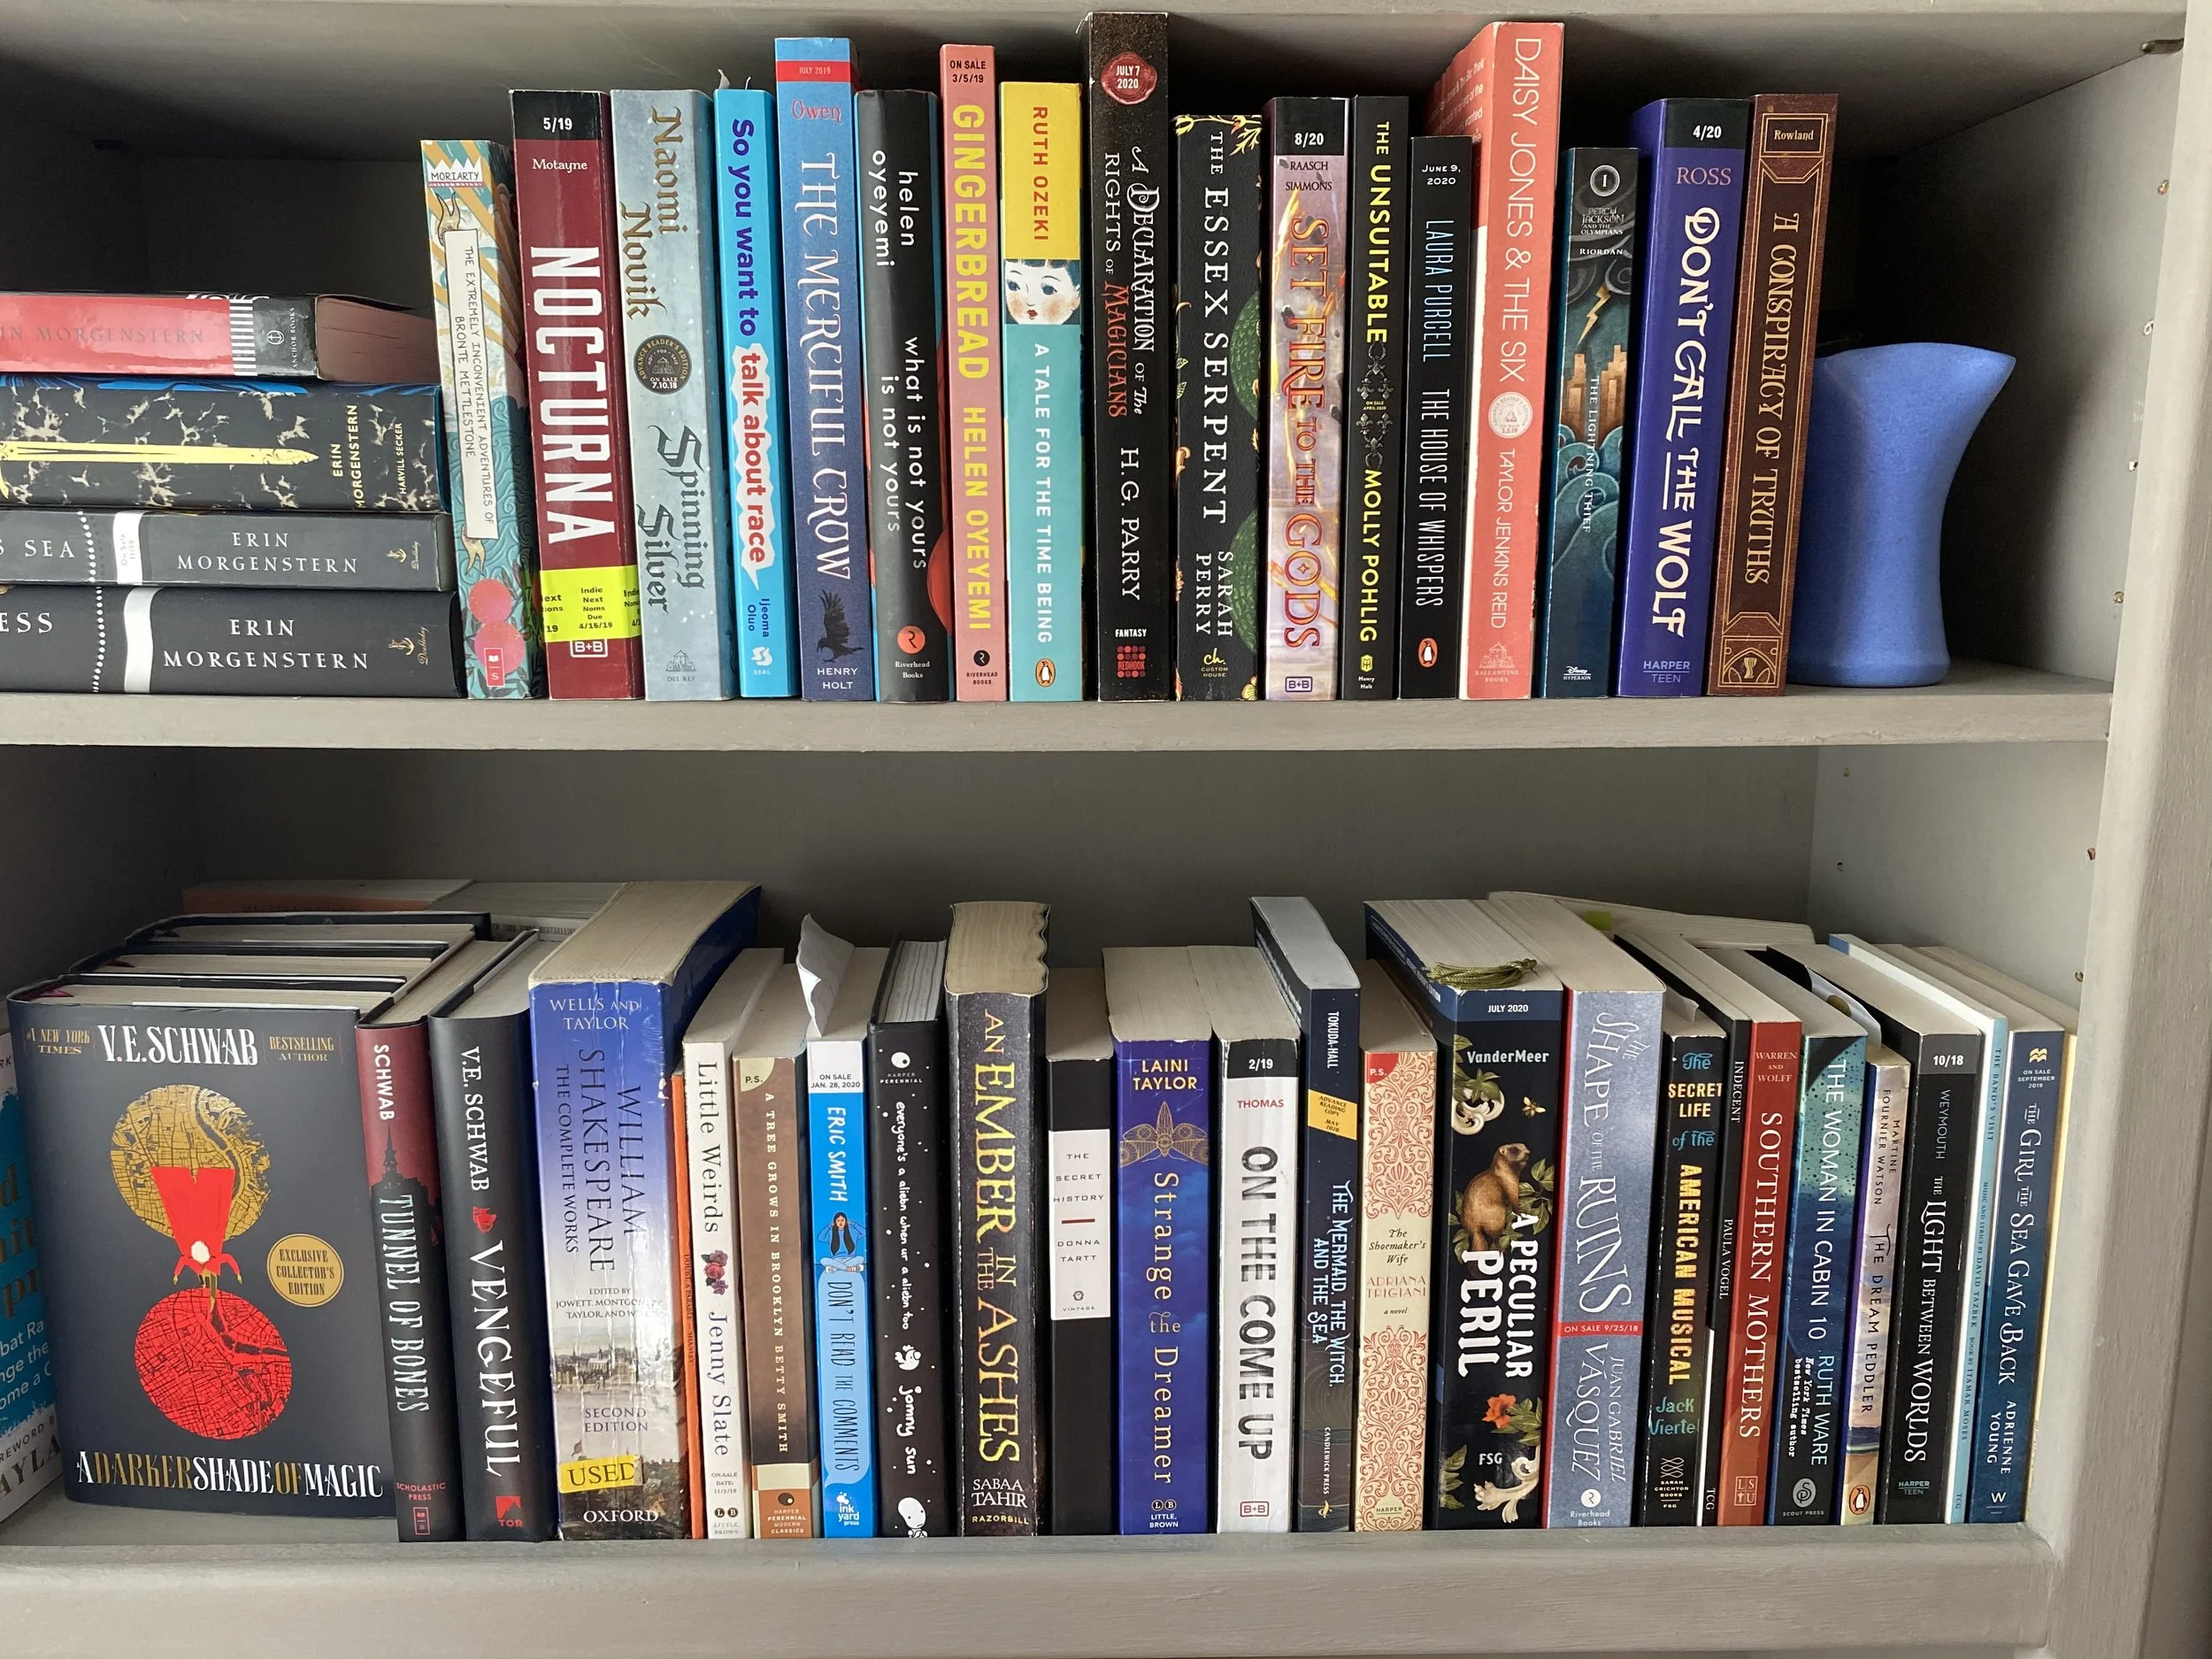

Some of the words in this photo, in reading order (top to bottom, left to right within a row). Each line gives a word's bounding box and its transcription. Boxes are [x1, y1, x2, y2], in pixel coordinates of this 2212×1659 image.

[964, 60, 986, 69] SALE
[1116, 65, 1134, 77] JULY
[1135, 65, 1140, 77] 7
[952, 73, 984, 83] 3/5/19
[1117, 78, 1140, 88] 2020
[543, 118, 572, 132] 5/19
[1693, 125, 1721, 140] 4/20
[732, 119, 755, 156] So
[1033, 107, 1048, 166] RUTH
[1294, 133, 1324, 146] 8/20
[1774, 130, 1814, 141] Rowland
[532, 159, 588, 173] Motayne
[650, 105, 688, 234] Naomi
[1290, 161, 1328, 171] RAASCH
[1451, 165, 1461, 174] 9,
[431, 172, 480, 181] MORIARTY
[1677, 167, 1732, 186] ROSS
[728, 165, 751, 218] you
[1286, 181, 1333, 191] SIMMONS
[868, 150, 895, 266] oyeyemi
[898, 172, 920, 246] helen
[1033, 176, 1048, 240] OZEKI
[464, 245, 475, 266] THE
[1425, 220, 1454, 276] LAURA
[618, 201, 668, 320] Novik
[734, 227, 758, 299] want
[465, 270, 479, 338] EXTREMELY
[740, 307, 758, 336] to
[1423, 284, 1453, 363] PURCELL
[455, 316, 468, 364] BRONTE
[471, 342, 488, 431] INCONVENIENT
[531, 247, 615, 544] NOCTURNA
[459, 371, 476, 457] METTLESTONE
[395, 422, 403, 457] SECKER
[398, 459, 407, 495] HARVILL
[477, 435, 492, 508] ADVENTURES
[484, 511, 495, 525] OF
[233, 534, 288, 547] ERIN
[178, 556, 357, 573] MORGENSTERN
[1195, 552, 1212, 635] PERRY
[1218, 551, 1233, 637] SARAH
[748, 604, 757, 632] Oluo
[230, 619, 295, 636] ERIN
[1115, 628, 1147, 637] FANTASY
[164, 650, 368, 669] MORGENSTERN
[1643, 661, 1690, 670] HARPER
[1652, 674, 1681, 683] TEEN
[550, 998, 604, 1011] WELLS
[611, 1001, 639, 1011] AND
[564, 1018, 629, 1030] TAYLOR
[270, 1036, 334, 1051] BESTSELLING
[1327, 1011, 1339, 1069] TOKUDA-HALL
[280, 1052, 327, 1062] AUTHOR
[1142, 1059, 1188, 1072] LAINI
[1248, 1059, 1272, 1070] 2/19
[1467, 1050, 1549, 1064] VanderMeer
[1933, 1056, 1963, 1066] 10/18
[374, 1045, 395, 1120] SCHWAB
[556, 1064, 570, 1098] THE
[1133, 1077, 1197, 1090] TAYLOR
[765, 1093, 775, 1102] A
[1668, 1083, 1723, 1098] SECRET
[1731, 1062, 1744, 1123] INDECENT
[1237, 1099, 1284, 1109] THOMAS
[1679, 1103, 1710, 1118] LIFE
[827, 1107, 846, 1145] ERIC
[1878, 1090, 1890, 1150] FOURNIER
[1935, 1090, 1951, 1159] WEYMOUTH
[766, 1110, 776, 1153] TREE
[557, 1102, 575, 1191] COMPLETE
[1888, 1119, 1901, 1173] MARTINE
[828, 1152, 848, 1202] SMITH
[1874, 1156, 1886, 1205] WATSON
[768, 1162, 779, 1217] GROWS
[564, 1195, 579, 1253] WORKS
[771, 1226, 780, 1243] IN
[1389, 1228, 1408, 1239] The
[1369, 1240, 1426, 1250] Shoemaker's
[280, 1249, 328, 1264] EXCLUSIVE
[1386, 1254, 1408, 1264] Wife
[276, 1264, 334, 1281] COLLECTOR'S
[1367, 1276, 1425, 1286] ADRIANA
[288, 1282, 325, 1295] EDITION
[771, 1252, 783, 1337] BROOKLYN
[1367, 1287, 1425, 1299] TRIGIANI
[470, 1239, 520, 1478] VENGEFUL
[774, 1345, 786, 1395] BETTY
[1816, 1356, 1834, 1406] RUTH
[585, 1408, 647, 1418] SECOND
[585, 1422, 648, 1432] EDITION
[777, 1403, 788, 1453] SMITH
[1811, 1414, 1831, 1466] WARE
[1987, 1412, 2000, 1463] YOUNG
[2001, 1402, 2016, 1474] ADRIENNE
[1479, 1453, 1502, 1465] FSG
[973, 1479, 1023, 1491] SABAA
[972, 1492, 1027, 1508] TAHIR
[583, 1509, 658, 1523] OXFORD
[972, 1516, 1029, 1525] RAZORBILL
